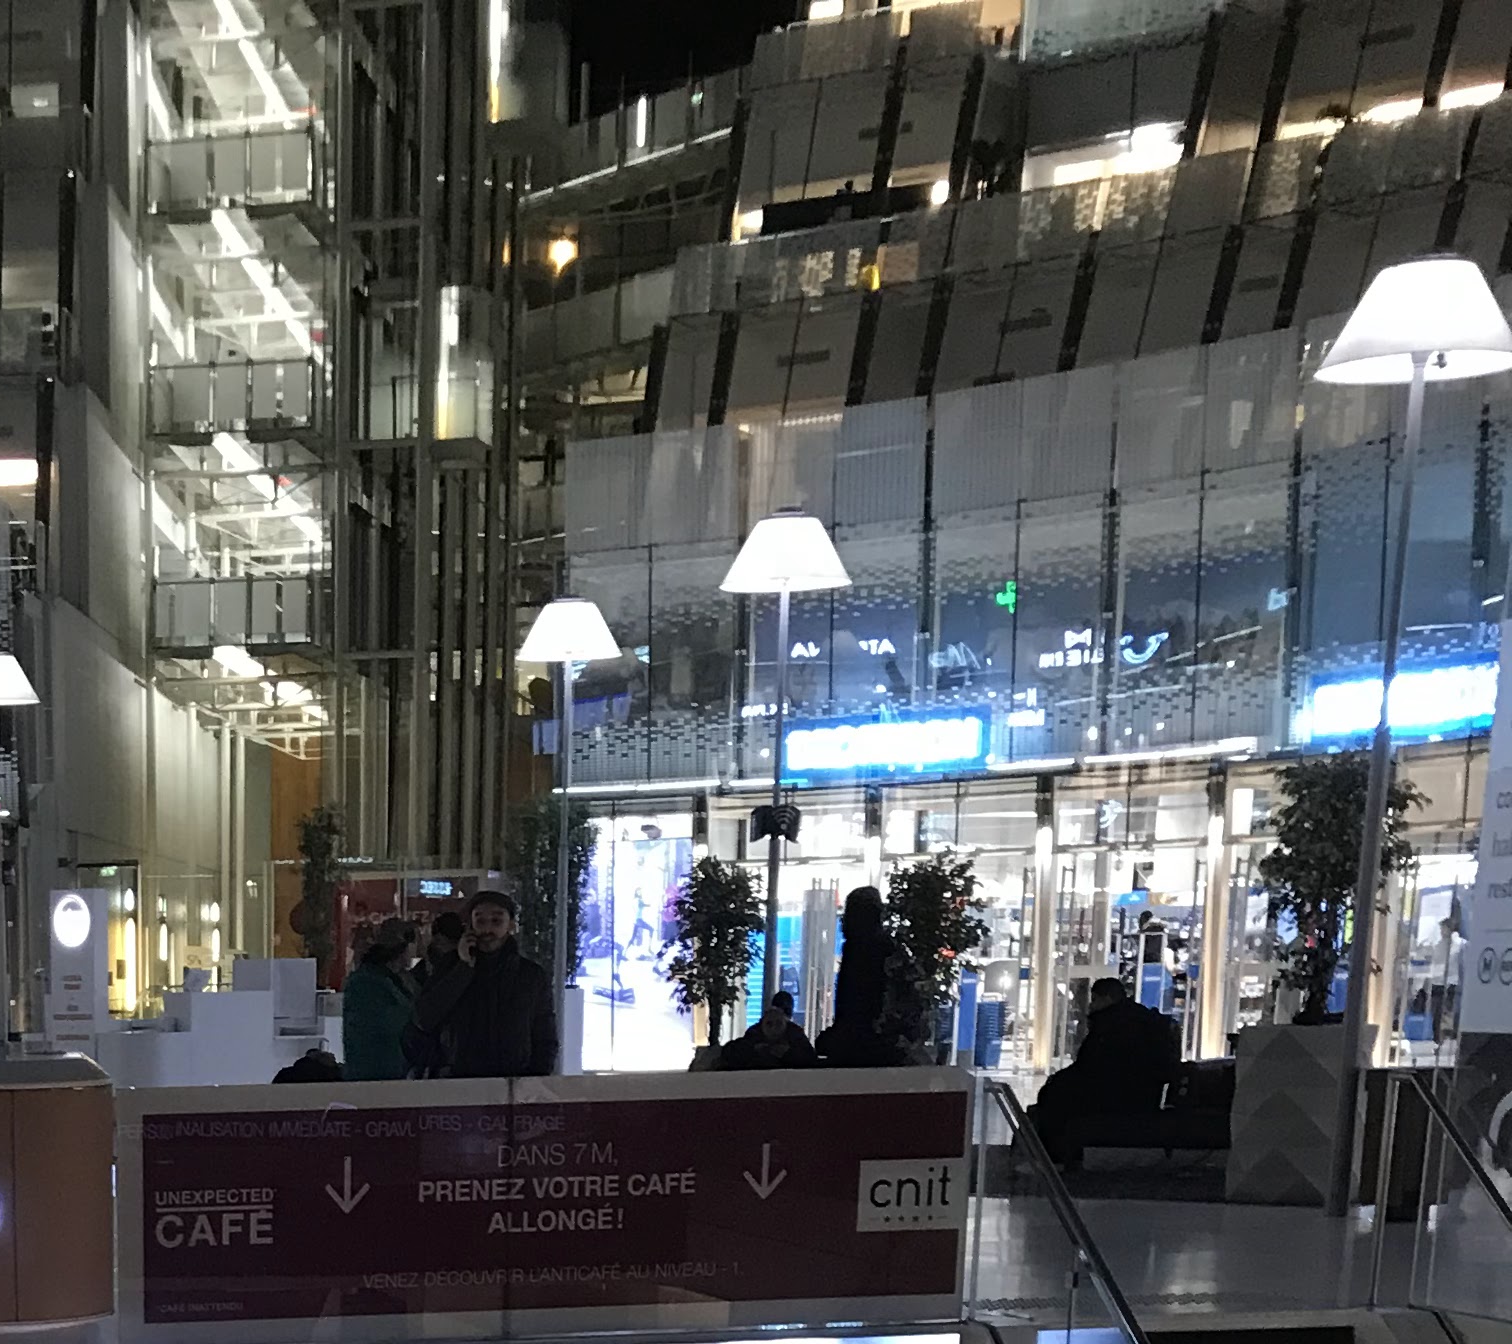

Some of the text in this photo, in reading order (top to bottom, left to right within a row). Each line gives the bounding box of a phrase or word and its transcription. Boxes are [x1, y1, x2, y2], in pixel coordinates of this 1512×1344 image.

[496, 1142, 567, 1168] DANS
[419, 1167, 697, 1204] PRENEZ VOTRE CAFÉ
[869, 1166, 951, 1208] cnit
[155, 1210, 275, 1248] CAFÉ
[362, 1272, 420, 1289] VENEZ
[626, 1265, 650, 1280] AU
[654, 1261, 717, 1278] NIVEAU
